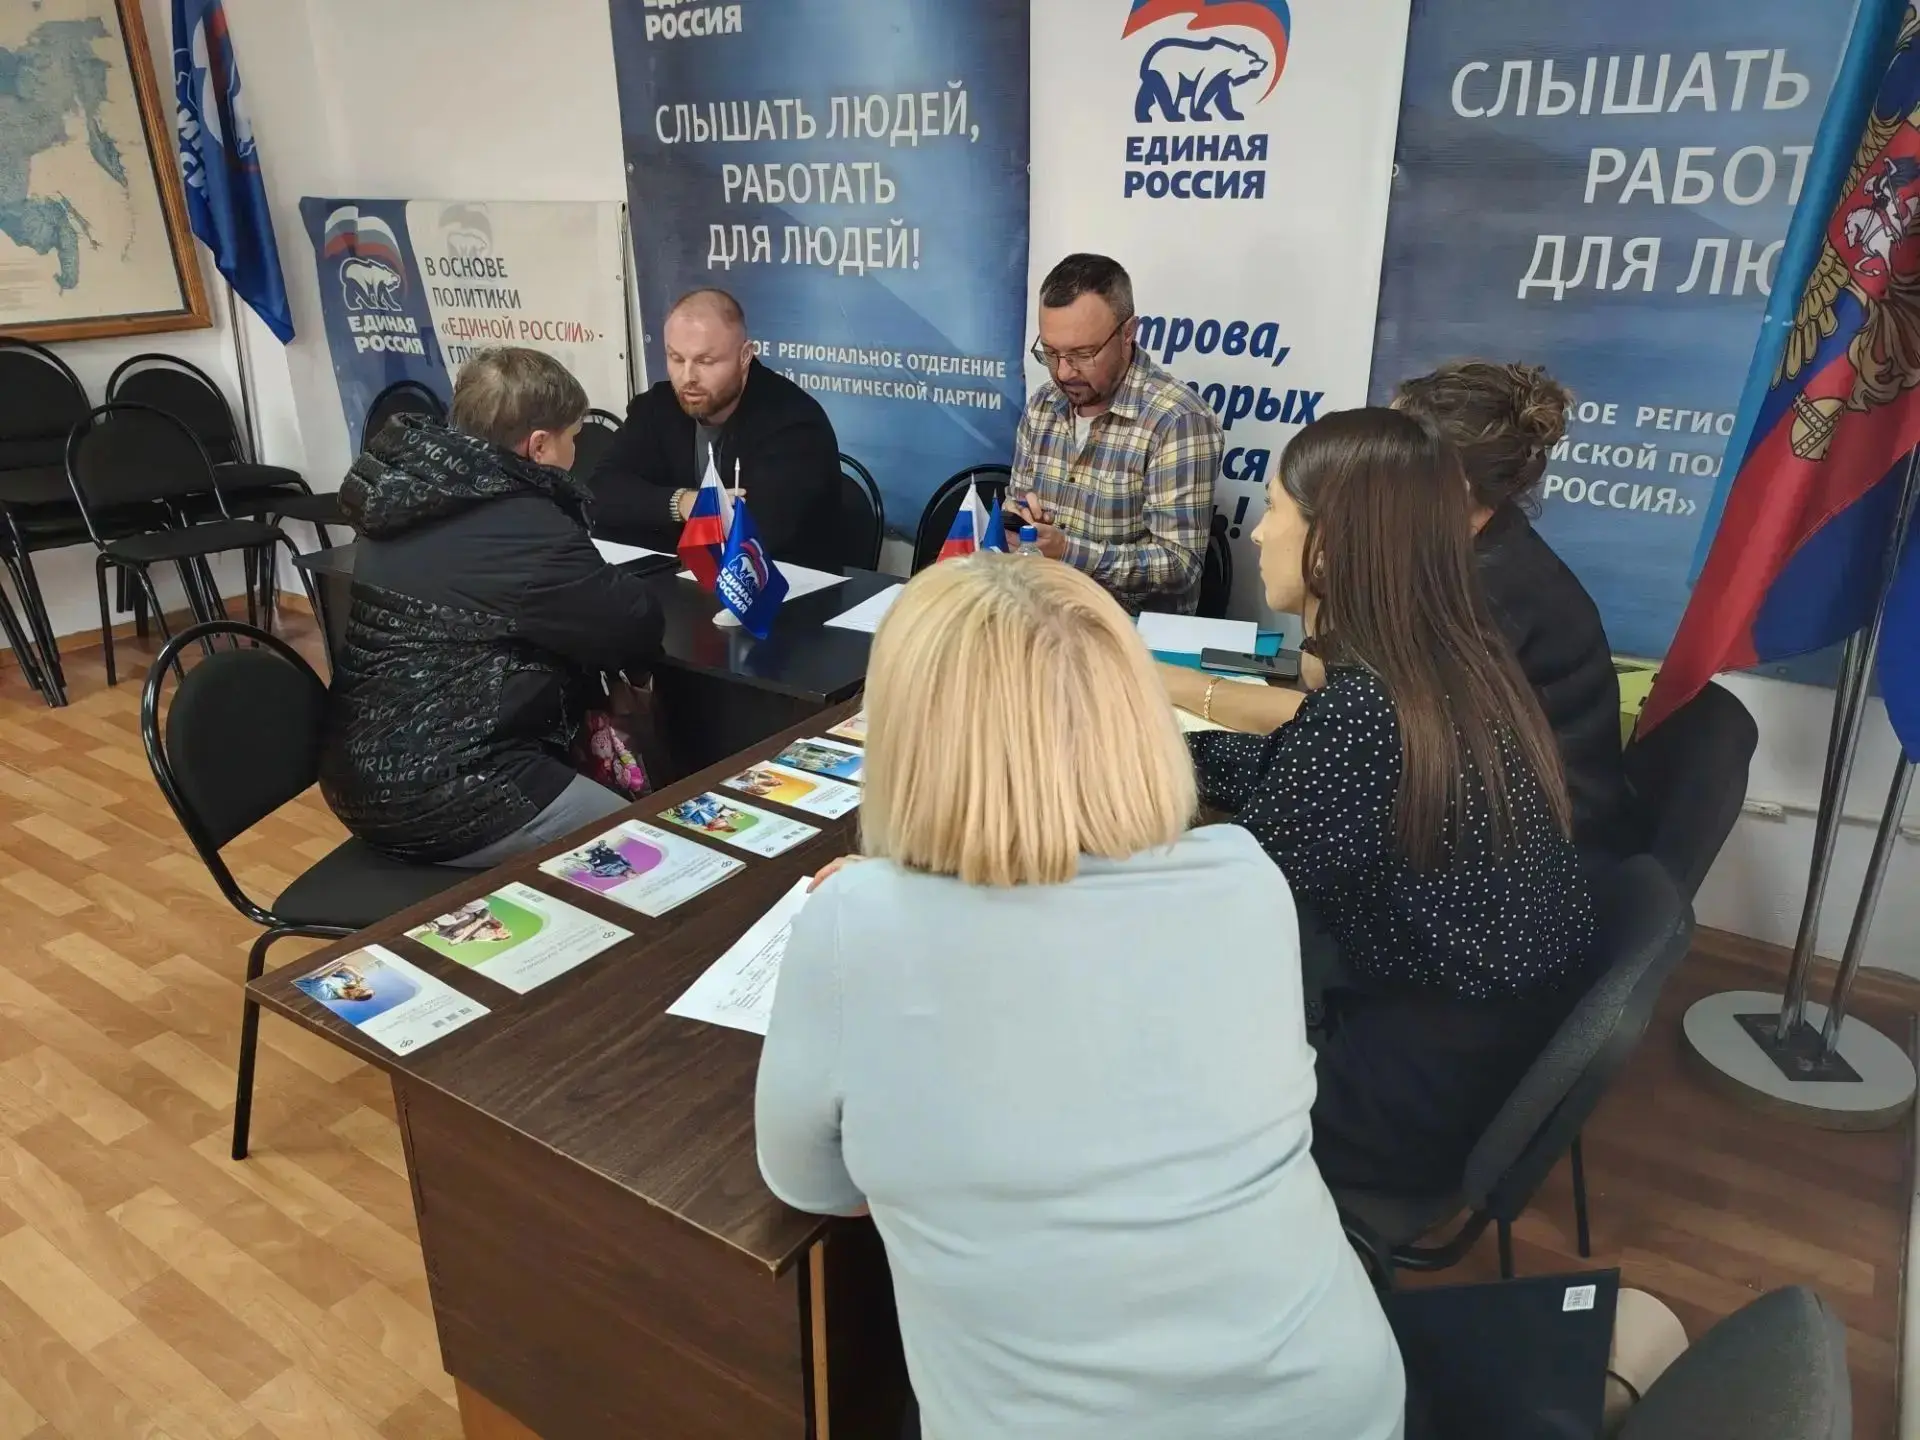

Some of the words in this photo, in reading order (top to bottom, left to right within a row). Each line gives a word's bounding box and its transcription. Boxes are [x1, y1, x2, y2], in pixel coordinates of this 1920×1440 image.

[645, 4, 743, 41] РОССИЯ
[1451, 48, 1811, 118] СЛЫШАТЬ
[655, 98, 817, 144] СЛЫШАТЬ
[825, 79, 980, 147] ЛЮДЕЙ,
[1125, 133, 1268, 166] ЕДИНАЯ
[722, 161, 896, 204] РАБОТАТЬ
[1123, 169, 1266, 200] РОССИЯ
[1583, 145, 1813, 206] РАБОТ
[707, 223, 771, 270] ДЛЯ
[780, 217, 920, 277] ЛЮДЕЙ!
[424, 256, 436, 277] В
[439, 256, 508, 278] ОСНОВЕ
[1517, 235, 1661, 301] ДЛЯ
[1676, 238, 1787, 296] ЛЮ
[432, 286, 522, 310] ПОЛИТИКИ
[347, 315, 418, 334] ЕДИНАЯ
[441, 315, 516, 341] «ЕДИНОЙ
[521, 319, 595, 343] РОССИИ»
[1135, 315, 1291, 367] трова,
[354, 336, 425, 356] РОССИЯ
[753, 340, 770, 357] ОЕ
[778, 342, 903, 369] РЕГИОНАЛЬНОЕ
[906, 353, 1007, 379] ОТДЕЛЕНИЕ
[799, 373, 928, 401] ПОЛИТИЧЕСКОЙ
[933, 387, 1002, 410] ПАРТИИ
[1187, 381, 1325, 431] орых
[1564, 401, 1619, 425] ОЕ
[1635, 406, 1736, 436] РЕГИО
[1222, 446, 1271, 483] ся
[1550, 434, 1658, 471] ЙСКОЙ
[1542, 474, 1697, 516] РОССИЯ»
[716, 574, 748, 614] РОССИЯ
[720, 567, 754, 606] ЕДИНАЯ
